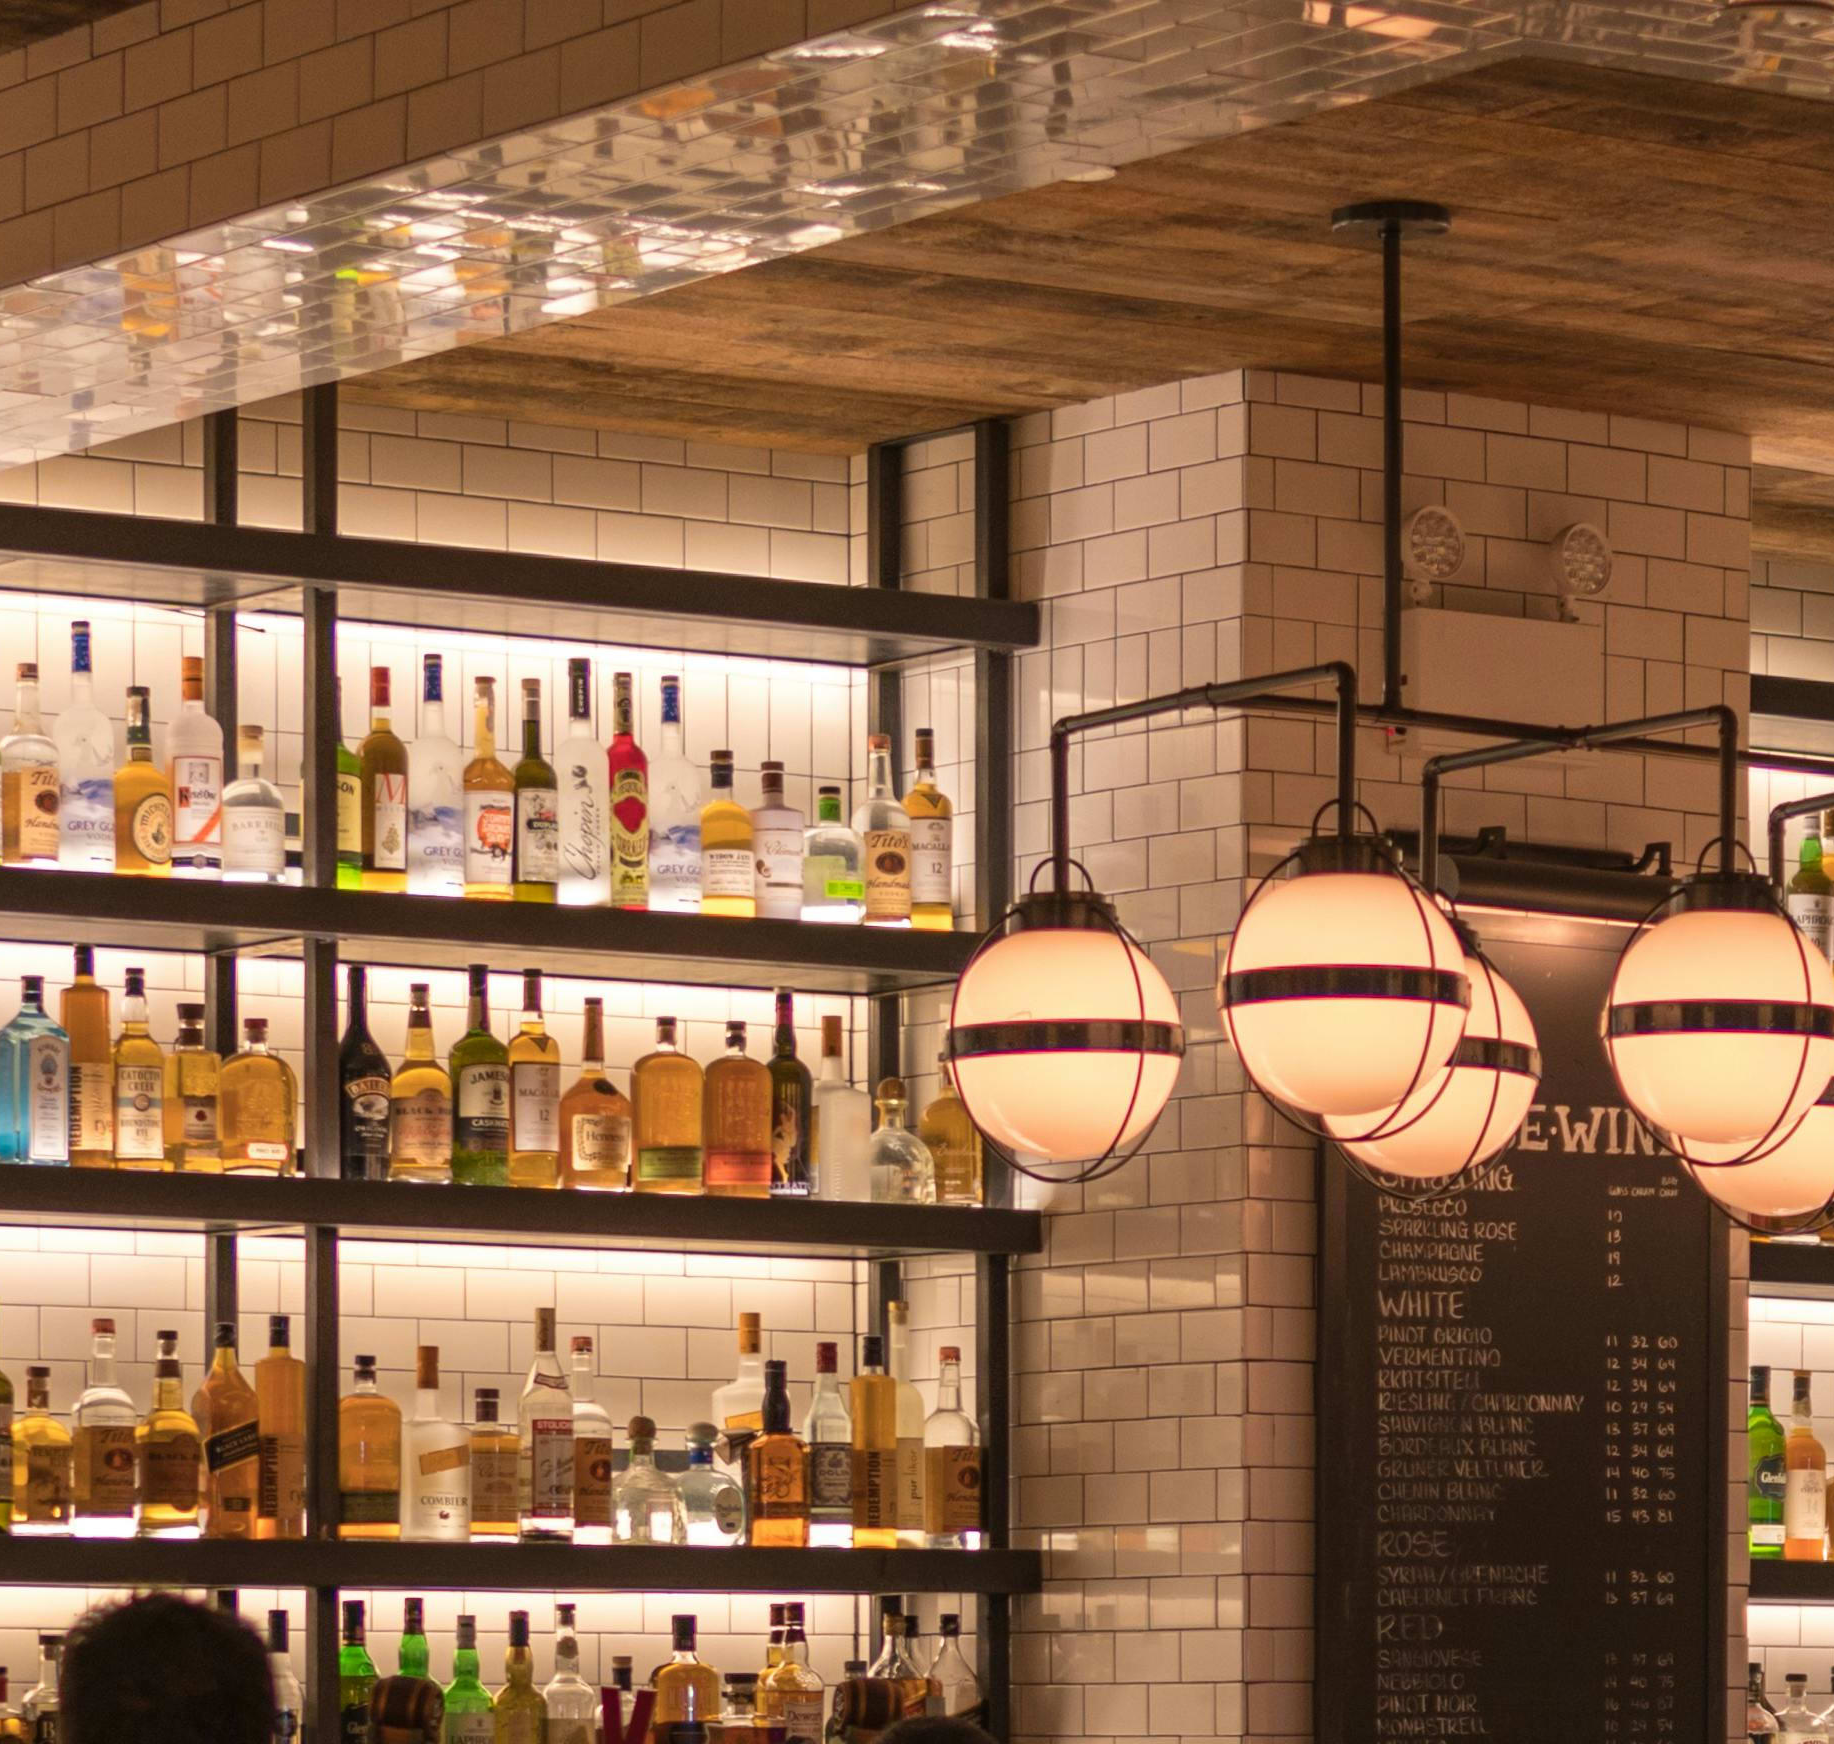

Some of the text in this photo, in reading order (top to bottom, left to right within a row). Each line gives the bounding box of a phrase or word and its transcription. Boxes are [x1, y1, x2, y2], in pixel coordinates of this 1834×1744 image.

[932, 862, 942, 874] 12
[70, 1066, 82, 1146] REDEMPTION
[540, 1110, 550, 1122] 12
[1379, 1198, 1467, 1216] PROSECCO
[1378, 1220, 1518, 1241] SPARKLING ROSE
[1379, 1241, 1621, 1265] CHAMPAGNE 19
[1378, 1263, 1624, 1288] LAMBRUSCO 12
[1377, 1290, 1465, 1319] WHITE
[1377, 1326, 1678, 1350] PINOT GRIGIO 11 32 60
[1379, 1348, 1676, 1371] VERMENTINO 12 34 64
[1606, 1379, 1621, 1392] 12
[1630, 1379, 1648, 1393] 34
[1657, 1379, 1676, 1393] 64
[1606, 1401, 1674, 1415] 10 29 54
[1377, 1416, 1675, 1436] SAUVIGNON BLANC 13 37 69
[1377, 1437, 1674, 1458] BORDEAUX BLANC 12 34 64
[265, 1437, 278, 1517] REDEMPTION
[1606, 1466, 1621, 1479] 14
[1631, 1466, 1650, 1480] 40
[1658, 1466, 1675, 1480] 75
[868, 1451, 880, 1526] REDEMPTION
[1377, 1481, 1676, 1502] CHENIN BLANC 11 32 60
[421, 1495, 469, 1507] COMBIER
[1377, 1504, 1673, 1524] CHARDONNAY 15 43 81
[1376, 1530, 1455, 1558] ROSE
[1605, 1570, 1675, 1584] 11 32 60
[1377, 1587, 1469, 1607] CABERNET
[1630, 1591, 1648, 1605] 37
[1656, 1592, 1674, 1606] 69
[1376, 1614, 1443, 1643] RED
[1376, 1649, 1482, 1669] SANGIOVESE
[1629, 1676, 1648, 1689] 40
[1376, 1694, 1428, 1713] PINOT
[1436, 1694, 1477, 1712] NOIR
